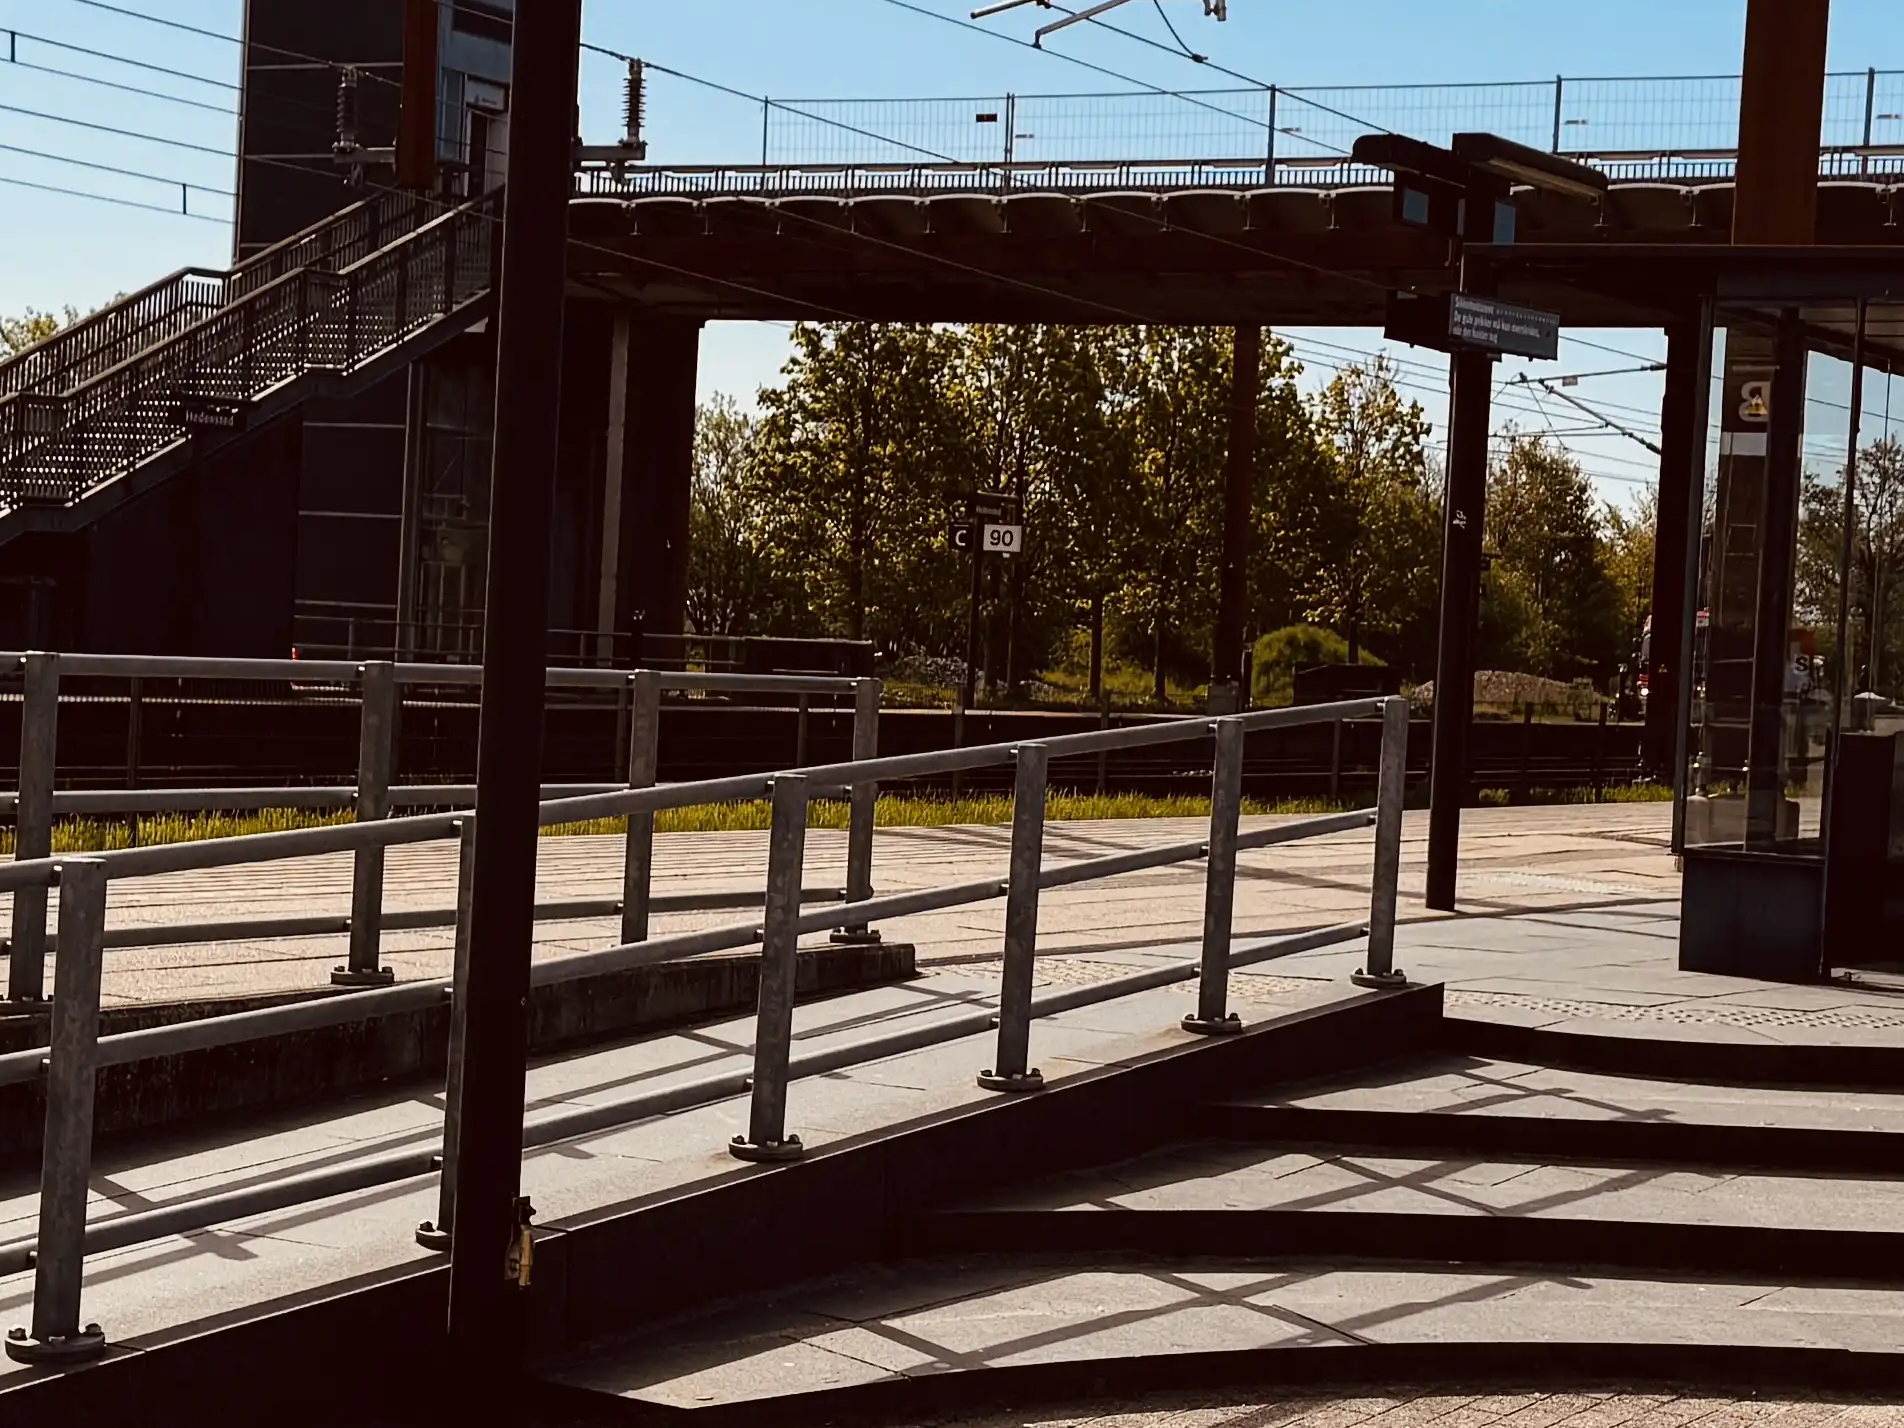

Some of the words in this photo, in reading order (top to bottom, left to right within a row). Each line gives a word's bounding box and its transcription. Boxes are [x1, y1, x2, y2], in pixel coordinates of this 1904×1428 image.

[185, 409, 234, 427] Hedensted
[954, 529, 968, 547] C
[989, 529, 1014, 547] 90
